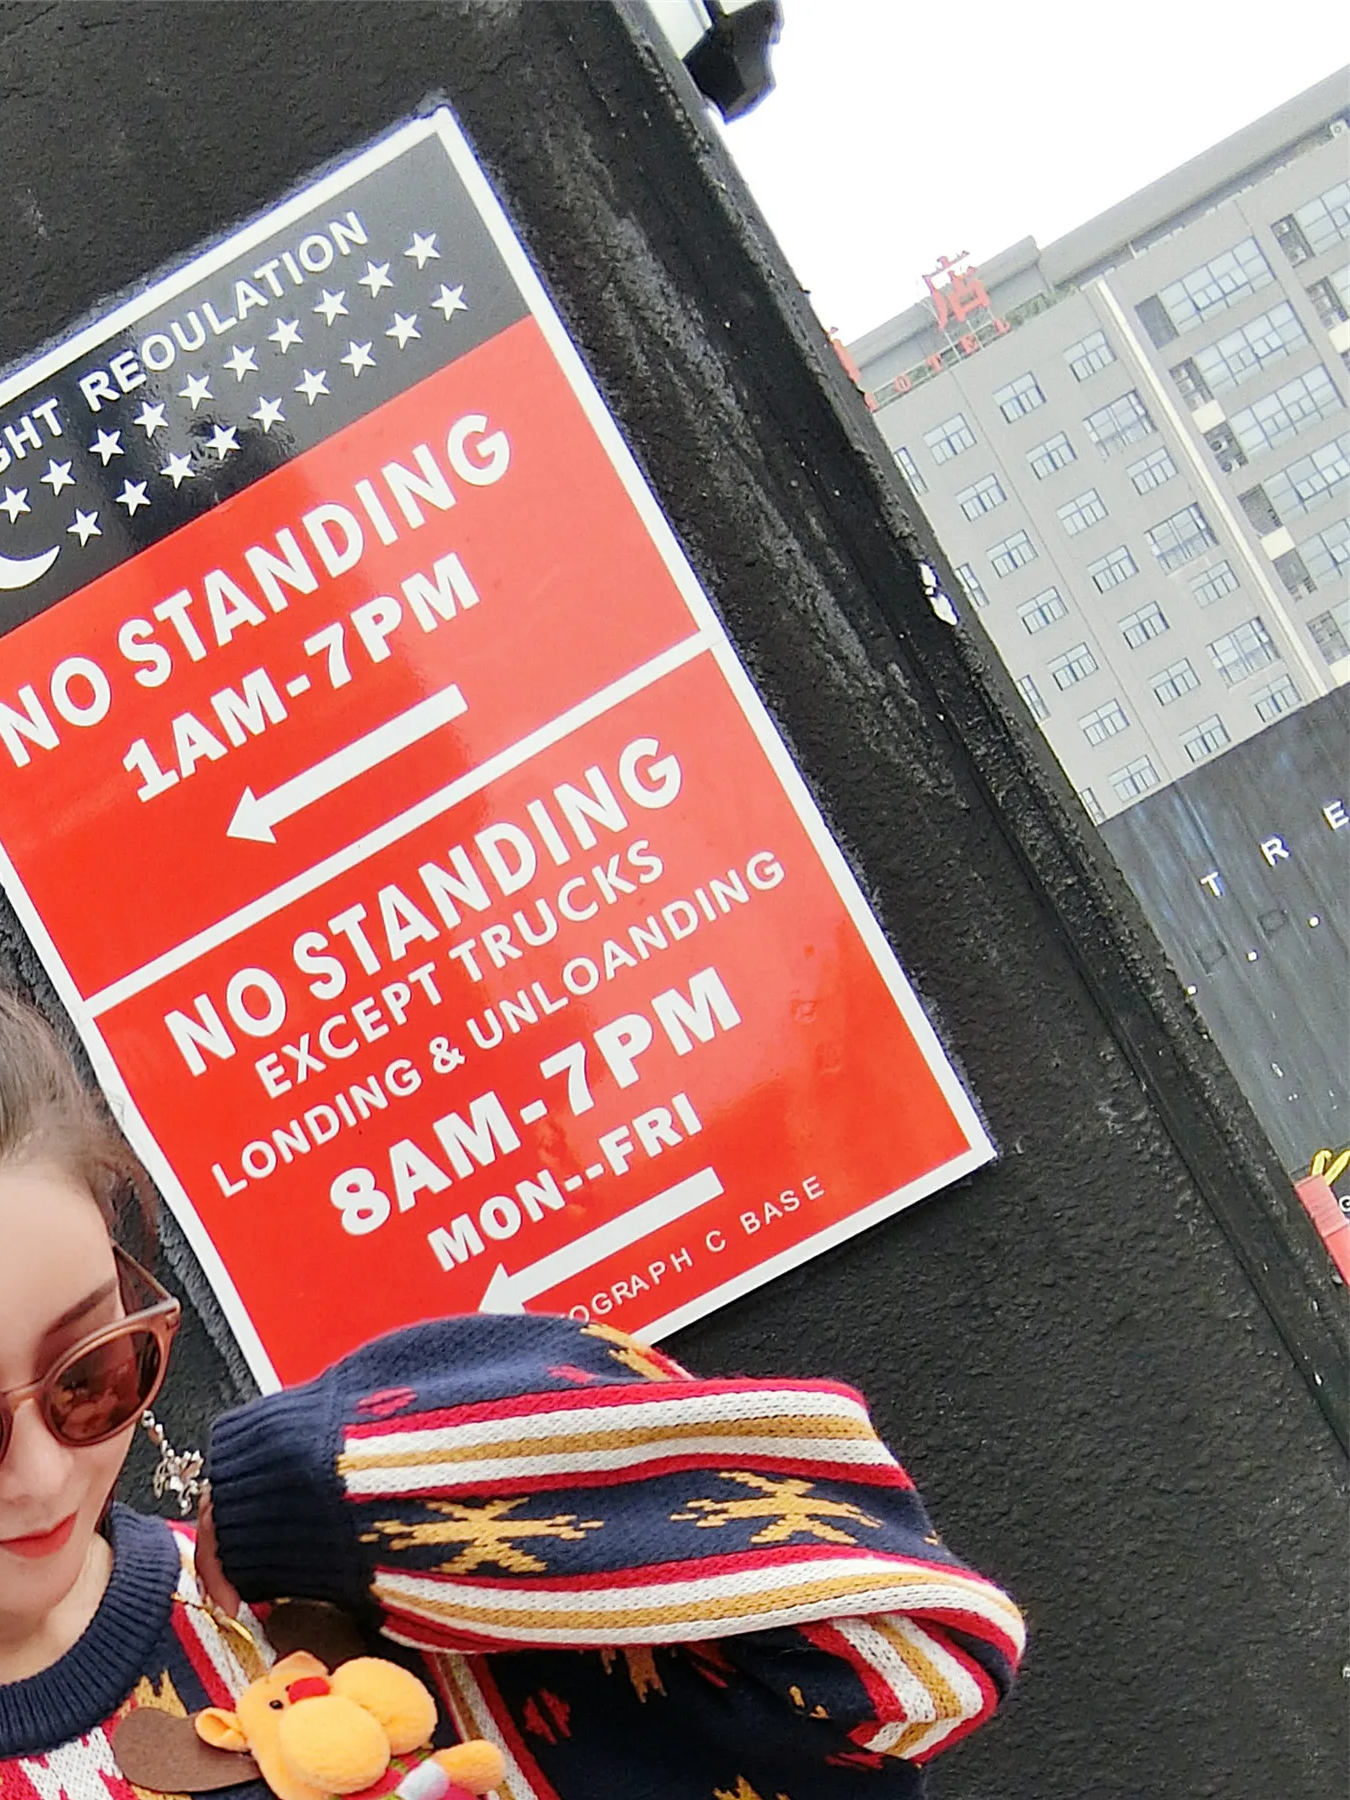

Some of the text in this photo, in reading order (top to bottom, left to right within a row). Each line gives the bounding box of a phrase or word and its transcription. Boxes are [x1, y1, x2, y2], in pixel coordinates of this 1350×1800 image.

[117, 413, 512, 688] STANDING
[122, 551, 481, 802] 1AM-7PM
[164, 736, 683, 1077] NO STANDING
[212, 850, 786, 1199] LONDING & UNLOANDING
[254, 838, 664, 1099] EXCEPT TRUCKS
[329, 965, 743, 1236] 8AM-7PM
[560, 1175, 826, 1324] OGRAPH C BASE
